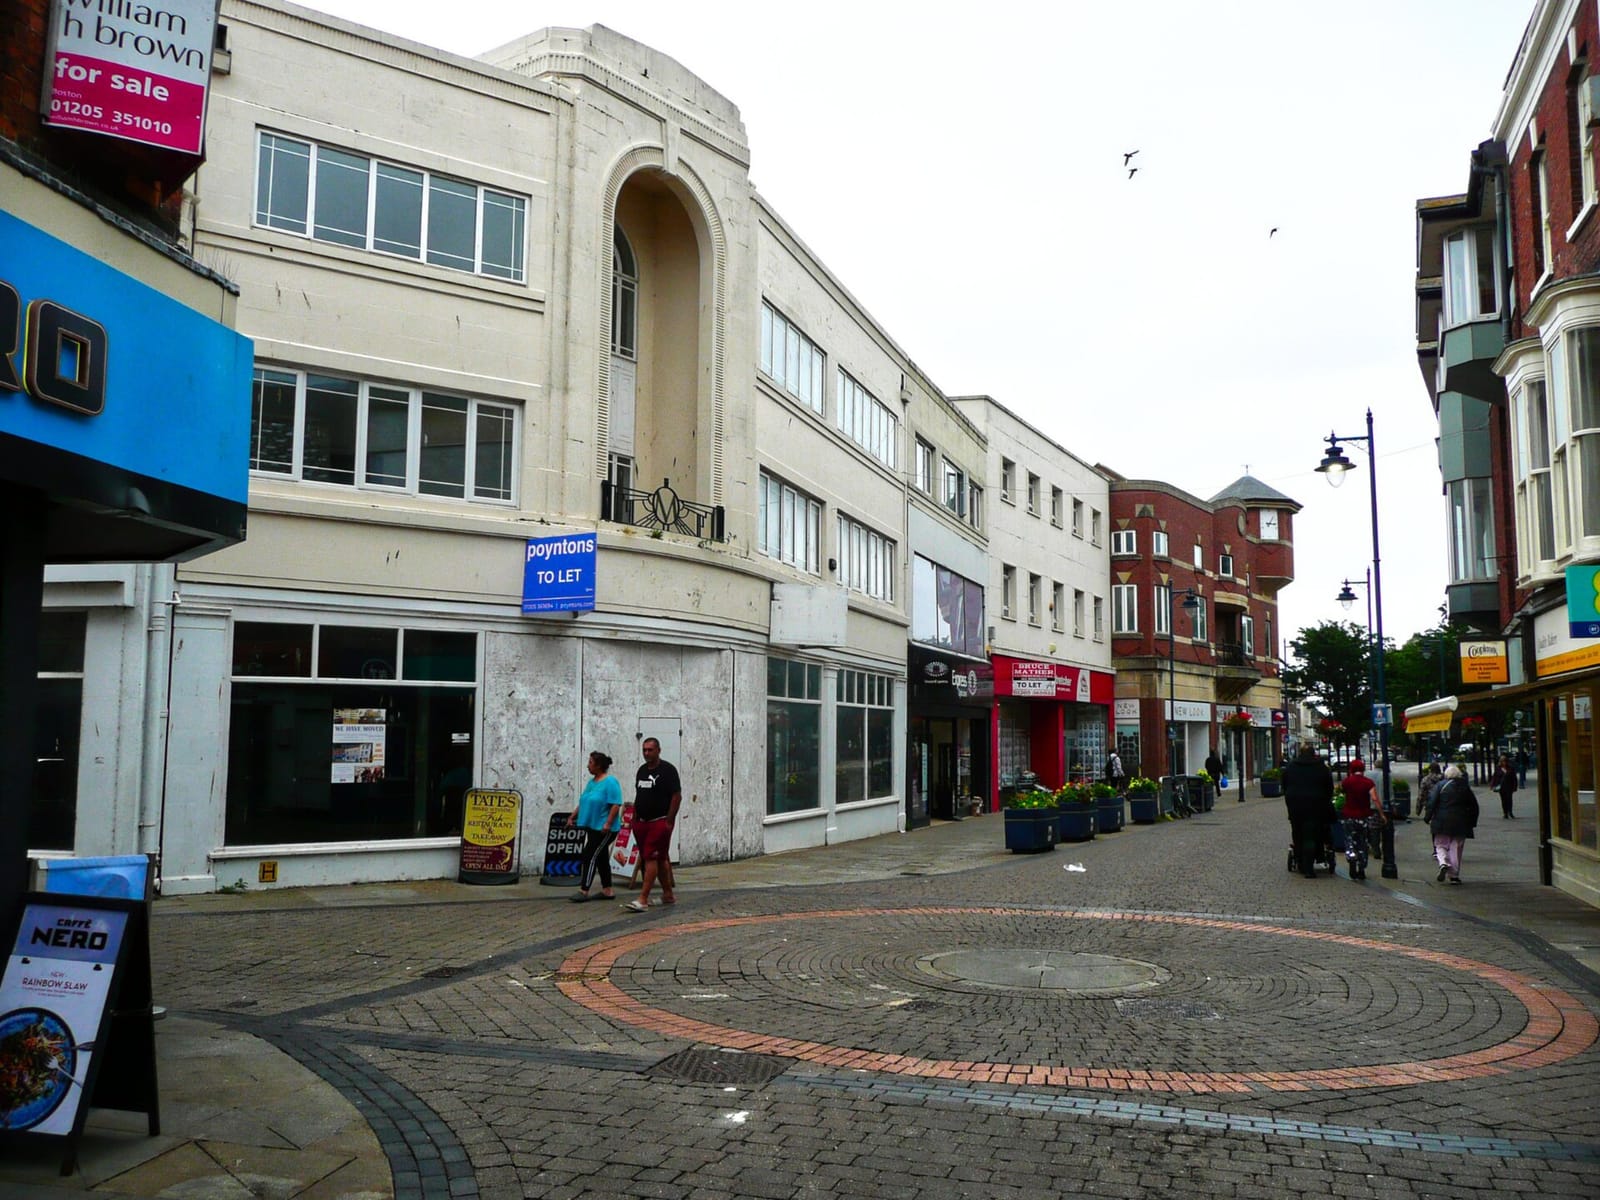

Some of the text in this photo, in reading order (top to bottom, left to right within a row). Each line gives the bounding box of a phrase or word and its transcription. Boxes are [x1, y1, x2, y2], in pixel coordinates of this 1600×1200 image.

[64, 10, 205, 72] h brown
[55, 58, 170, 102] for sale
[50, 99, 172, 135] 01205 351010
[527, 539, 595, 562] poyntons
[537, 568, 583, 585] TO LET
[471, 793, 516, 808] TATES
[468, 820, 514, 829] RESTAURANT
[472, 833, 507, 841] TAKEAWAY
[549, 829, 586, 840] SHOP
[547, 842, 583, 854] OPEN
[262, 863, 276, 880] H
[31, 926, 108, 950] NERO
[22, 977, 89, 990] RAINBOW SLAW
